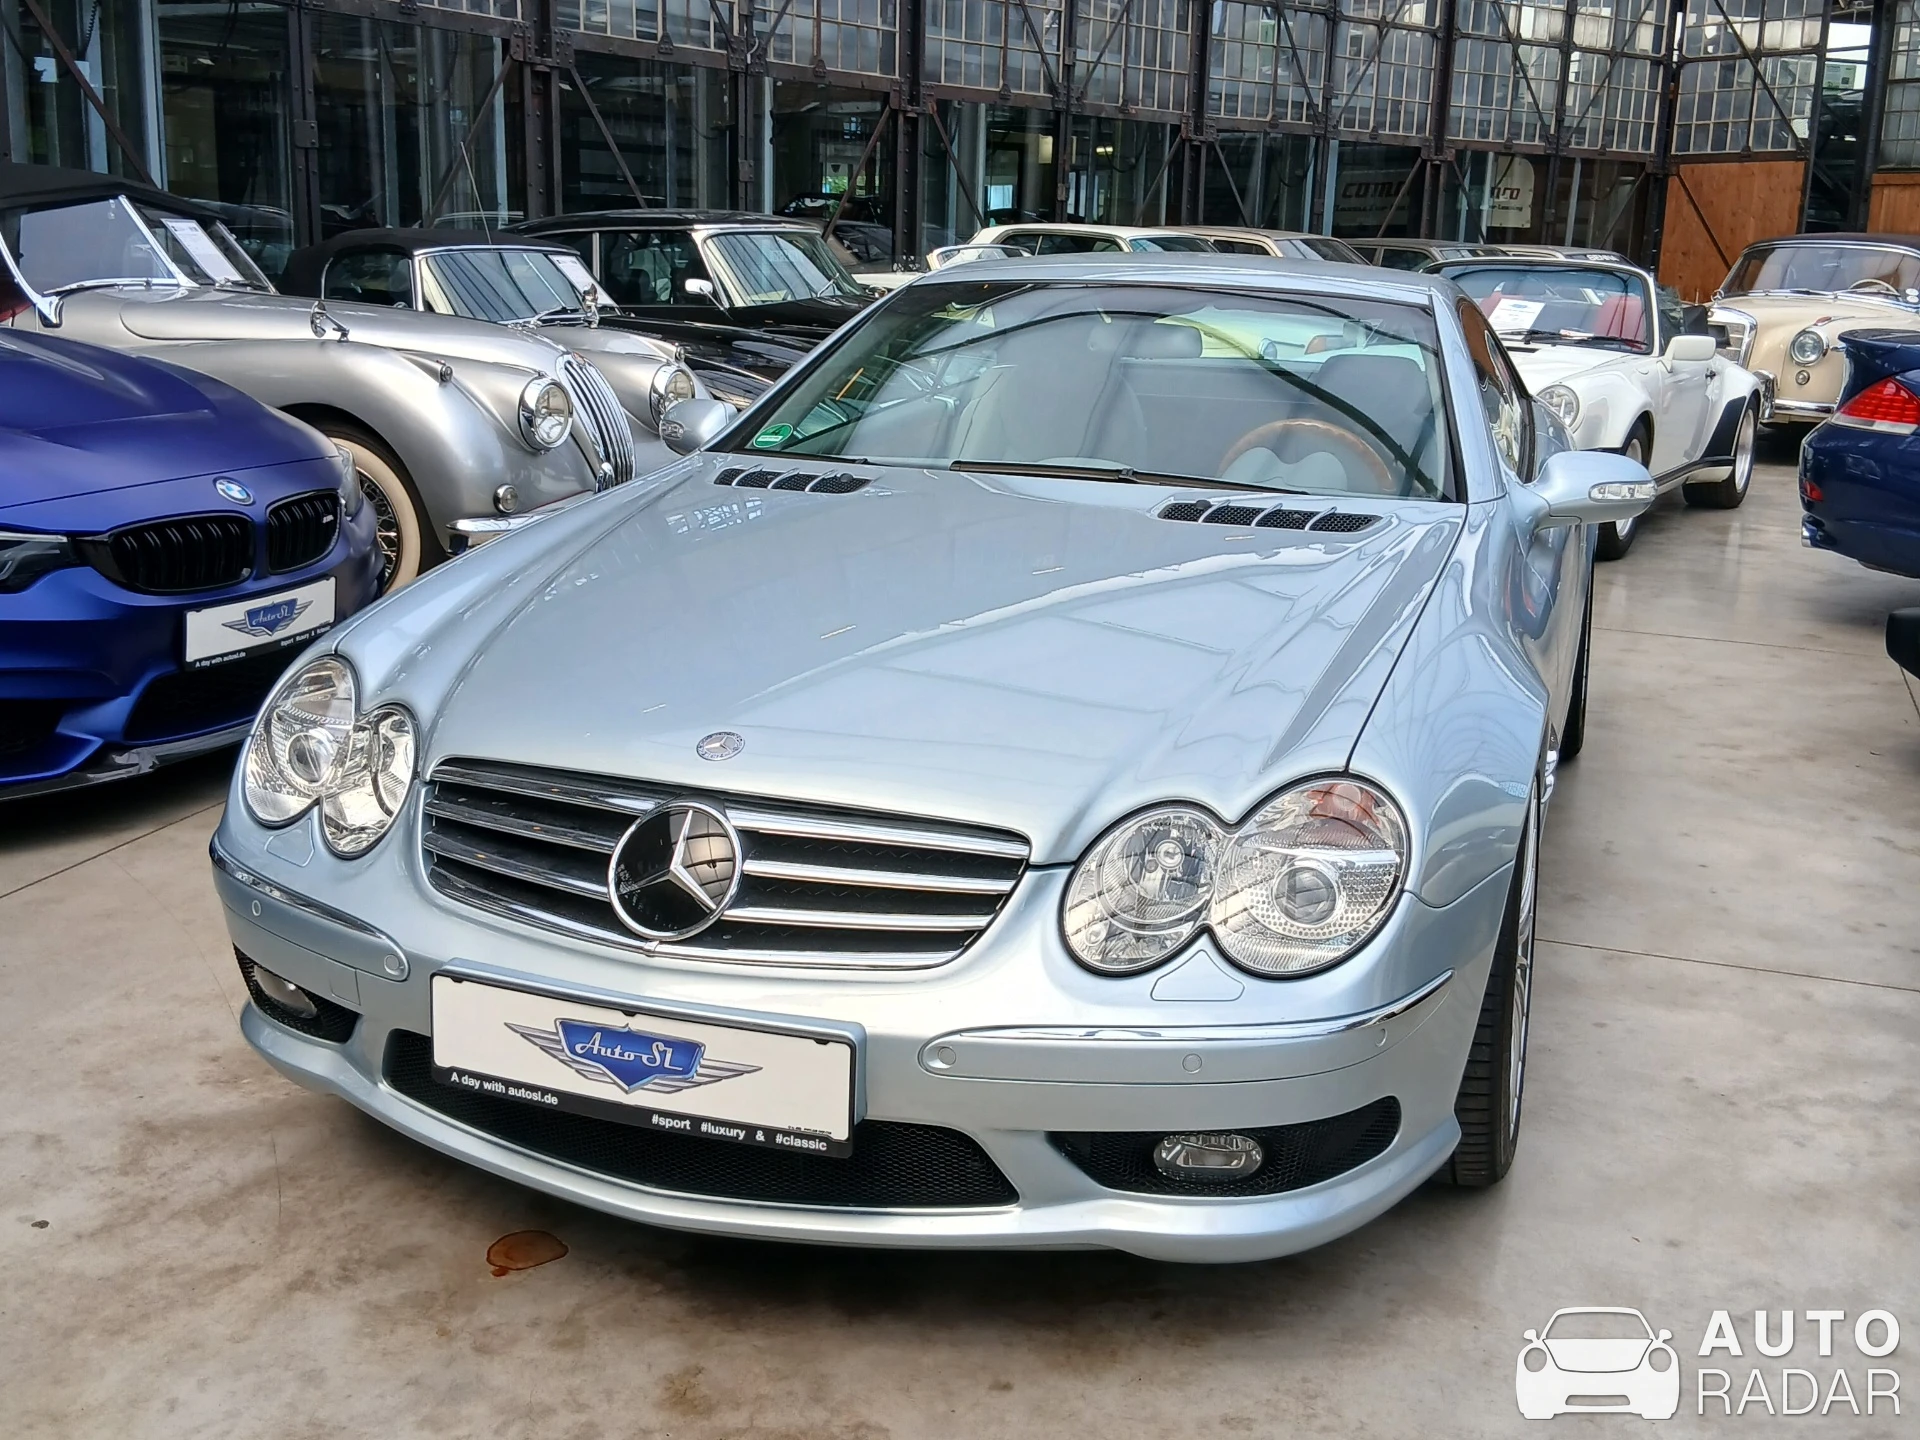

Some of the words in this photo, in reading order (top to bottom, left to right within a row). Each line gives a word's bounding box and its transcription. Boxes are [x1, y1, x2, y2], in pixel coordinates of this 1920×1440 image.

[451, 1072, 459, 1083] A
[461, 1075, 480, 1090] day
[483, 1080, 505, 1093] with
[508, 1086, 558, 1105] autosl.de
[652, 1113, 691, 1130] #sport
[700, 1121, 746, 1140] #luxury
[755, 1130, 766, 1142] &
[775, 1133, 827, 1151] #classic
